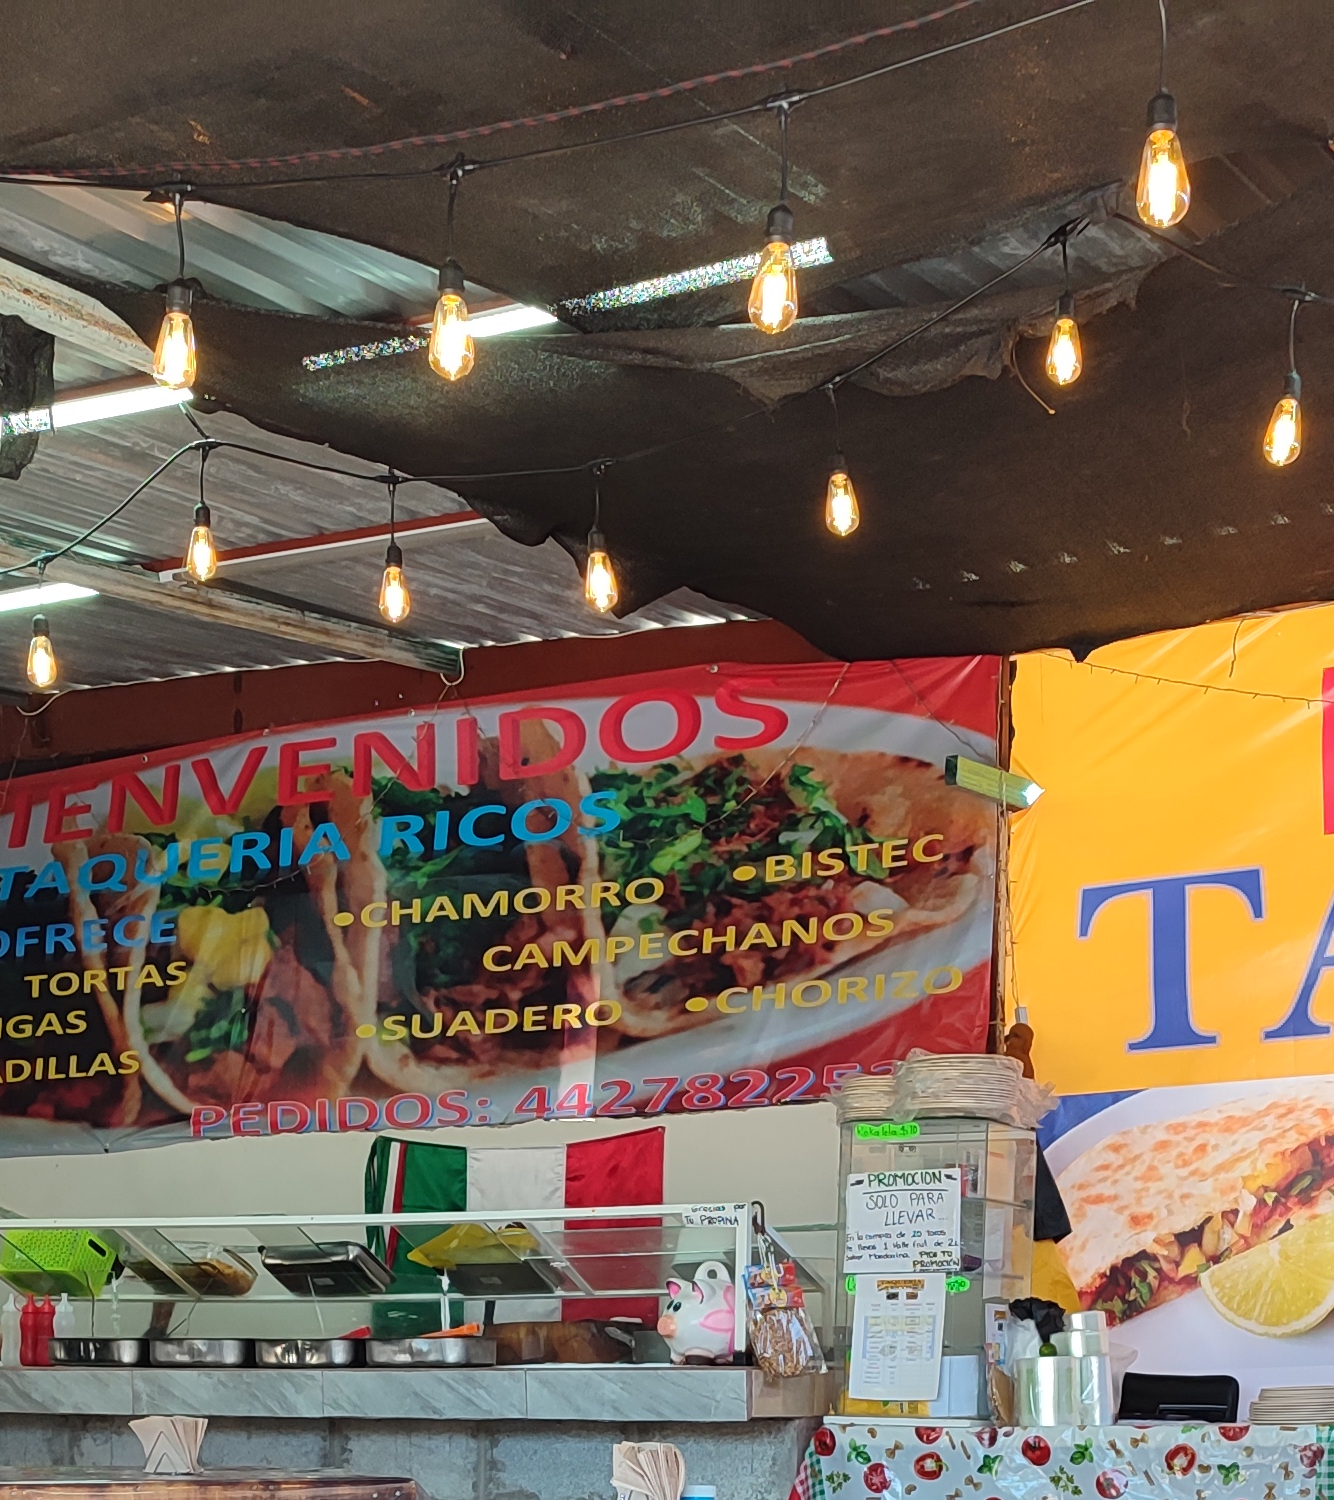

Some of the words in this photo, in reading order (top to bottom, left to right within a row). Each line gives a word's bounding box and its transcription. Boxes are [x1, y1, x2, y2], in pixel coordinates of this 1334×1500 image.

[378, 790, 623, 856] RICOS
[764, 834, 945, 885] BISTEC
[359, 876, 665, 929] CHAMORRO
[482, 908, 896, 973] CAMPECHANOS
[23, 961, 188, 999] TORTAS
[715, 966, 964, 1015] CHORIZO
[380, 999, 623, 1041] SUADERO
[190, 1090, 490, 1138] PEDIDOS:
[865, 1193, 899, 1211] SOLO
[909, 1191, 944, 1207] PARA
[867, 1170, 943, 1188] PROMOCION
